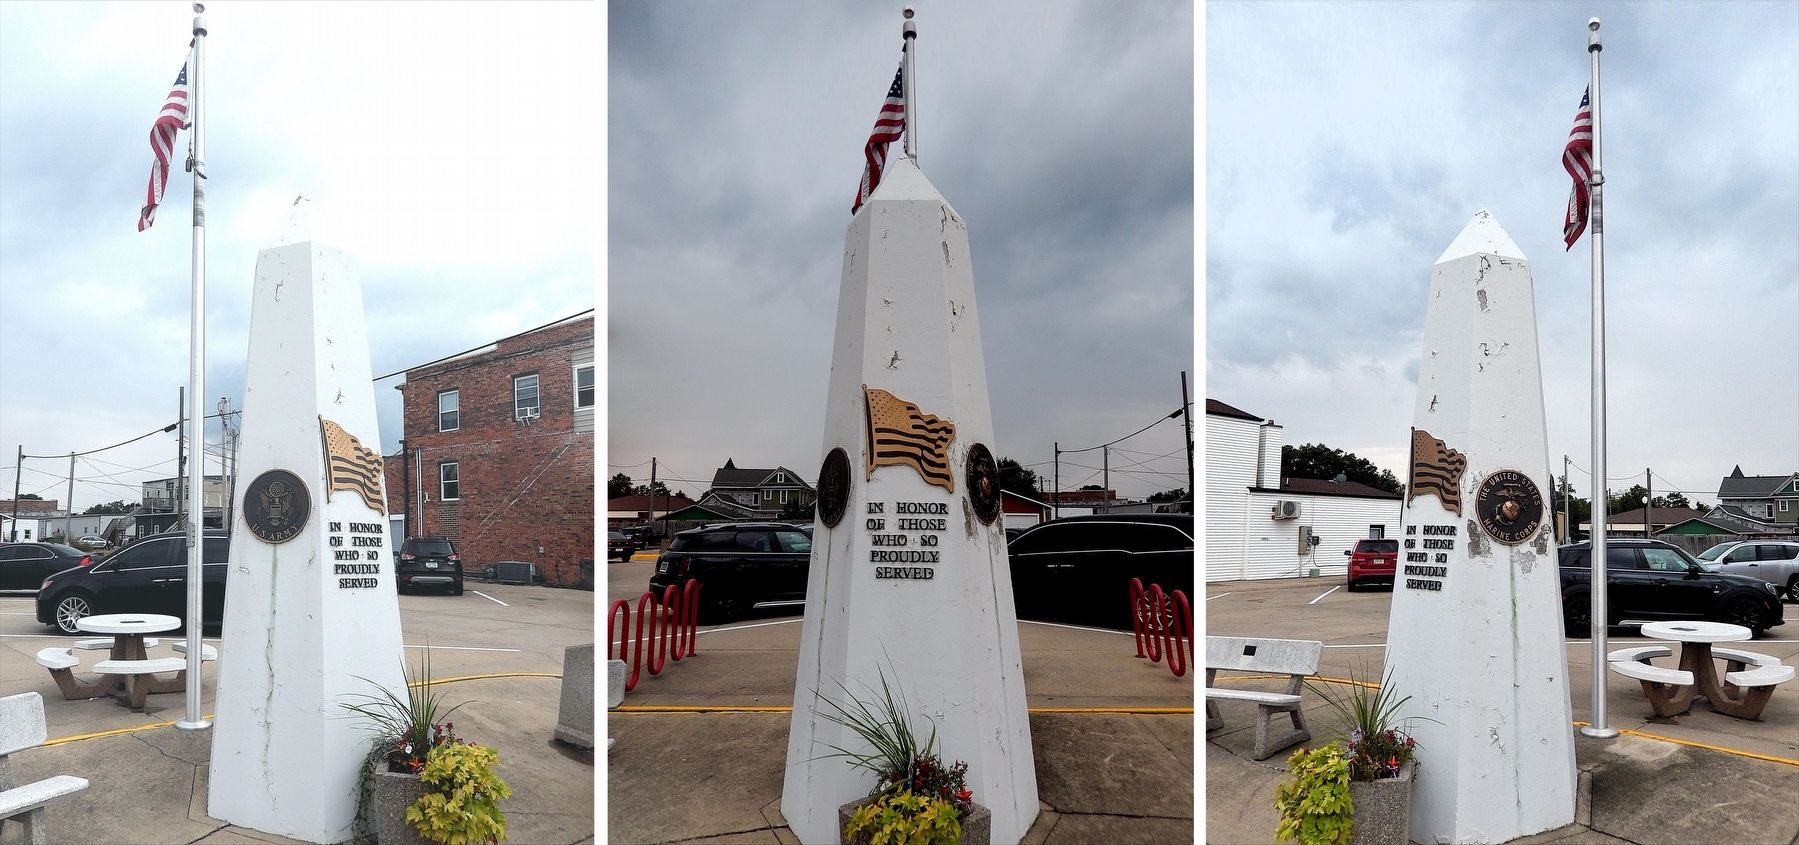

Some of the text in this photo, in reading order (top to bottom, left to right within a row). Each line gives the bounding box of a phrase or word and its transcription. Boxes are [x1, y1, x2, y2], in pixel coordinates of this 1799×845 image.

[1480, 472, 1541, 506] THE UNITED STATES
[867, 502, 949, 514] IN HONOR
[329, 522, 383, 534] IN HONOR
[866, 518, 946, 531] OF THOSE
[1406, 525, 1457, 536] IN HONOR
[1483, 518, 1538, 541] MARINE CORPS
[268, 522, 298, 541] ARMY
[329, 536, 383, 547] OF THOSE
[872, 534, 938, 546] WHO SO
[1404, 538, 1455, 550] OF THOSE
[334, 550, 379, 560] WHO SO
[870, 550, 940, 562] PROUDLY
[1406, 552, 1448, 563] WHO SO
[334, 564, 380, 574] PROUDLY
[876, 566, 934, 579] SERVED
[1404, 565, 1447, 577] PROUDLY
[339, 578, 378, 588] SERVED
[1405, 578, 1443, 591] SERVED
